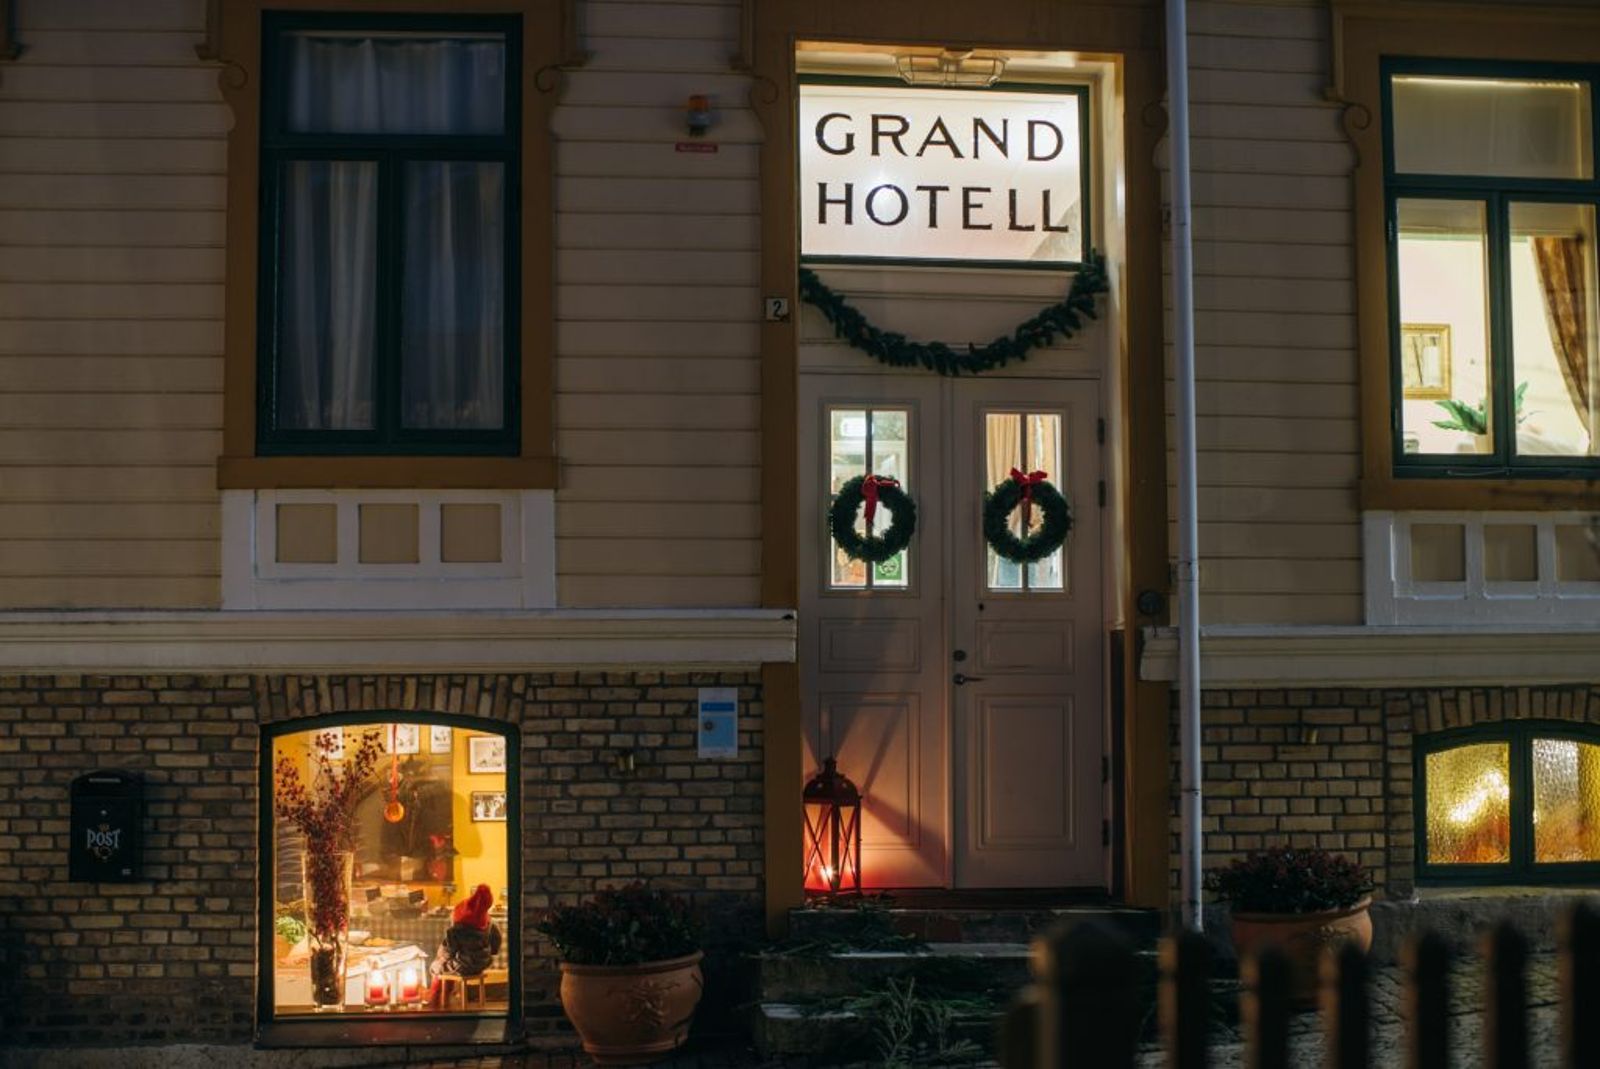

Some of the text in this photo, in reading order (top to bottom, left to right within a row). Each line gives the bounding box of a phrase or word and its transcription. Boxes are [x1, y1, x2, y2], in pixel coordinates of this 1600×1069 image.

[815, 113, 1064, 161] GRAND
[817, 182, 1069, 232] HOTELL
[772, 300, 782, 318] 2
[86, 828, 121, 849] POST
